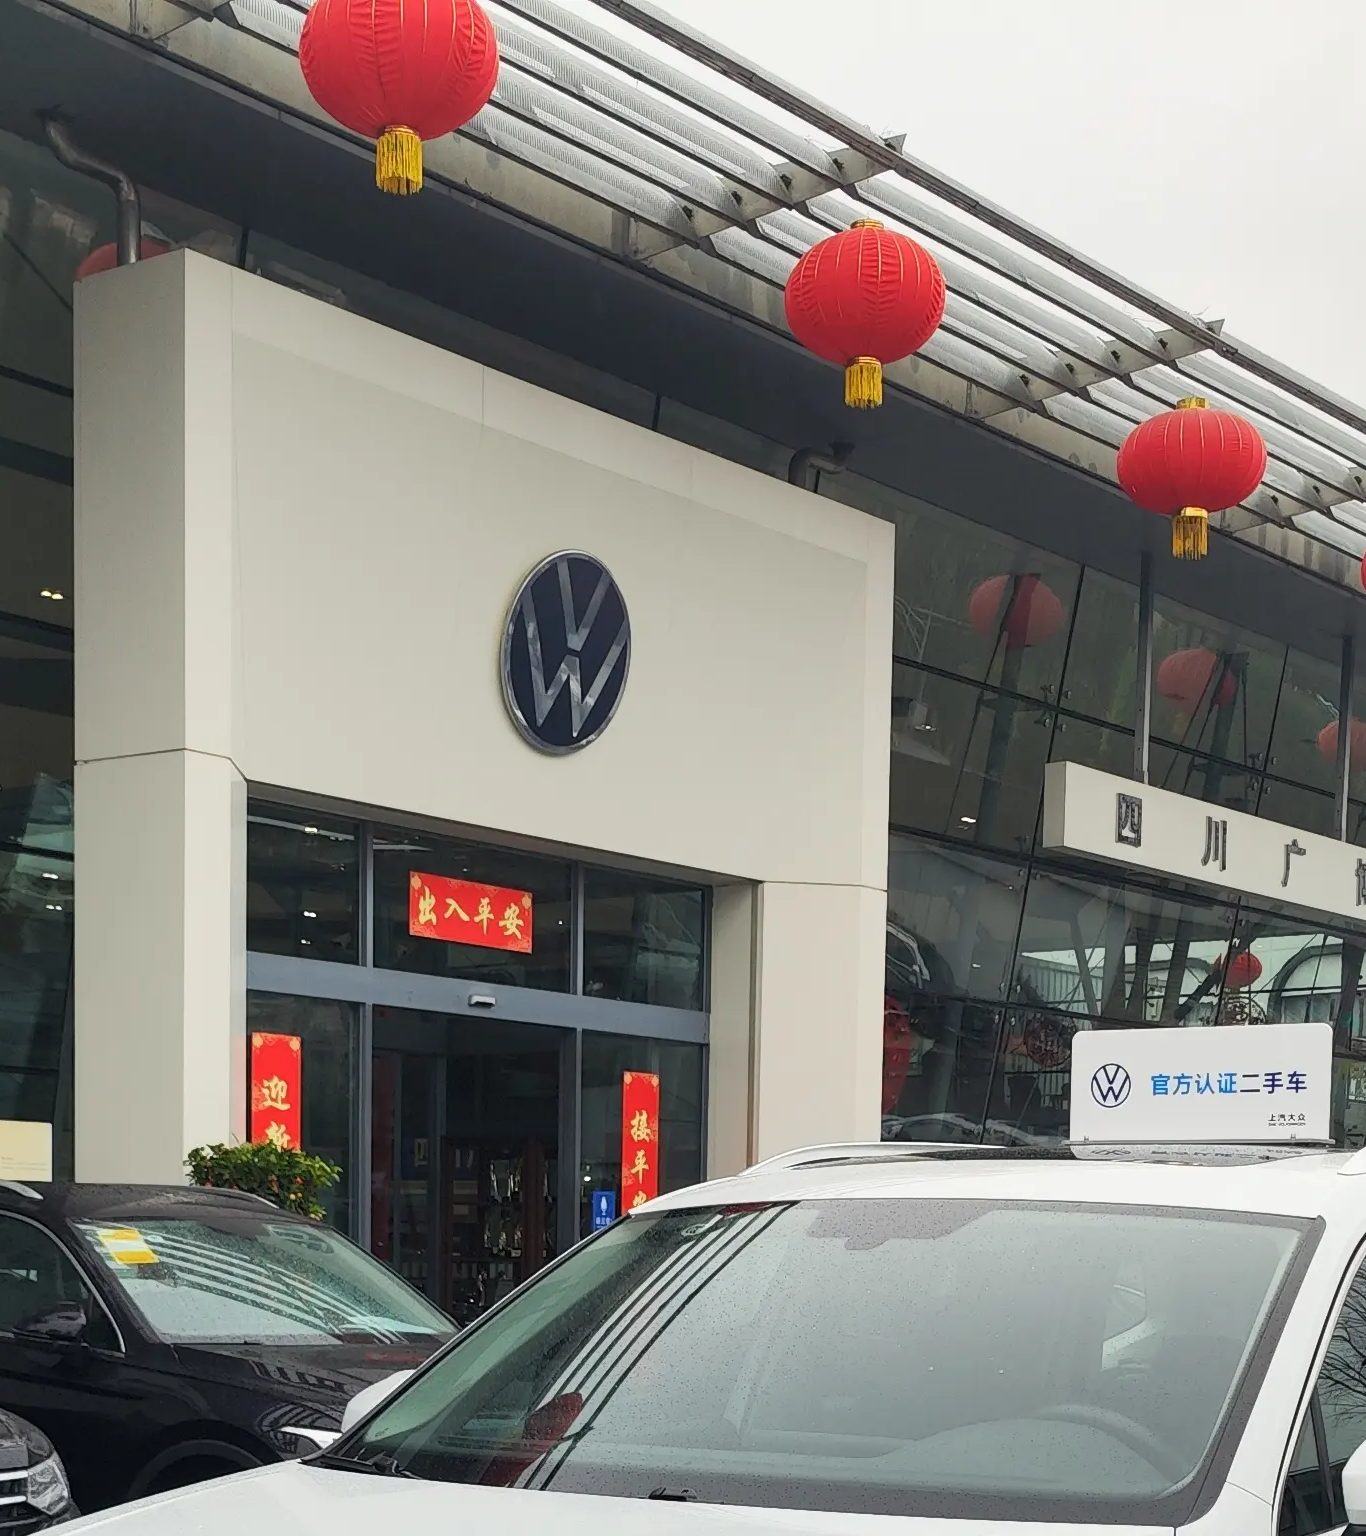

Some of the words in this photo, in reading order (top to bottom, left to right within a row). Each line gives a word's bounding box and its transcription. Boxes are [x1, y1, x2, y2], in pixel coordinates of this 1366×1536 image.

[418, 886, 525, 937] 出入平安
[1151, 1071, 1308, 1096] 官方认证二手车
